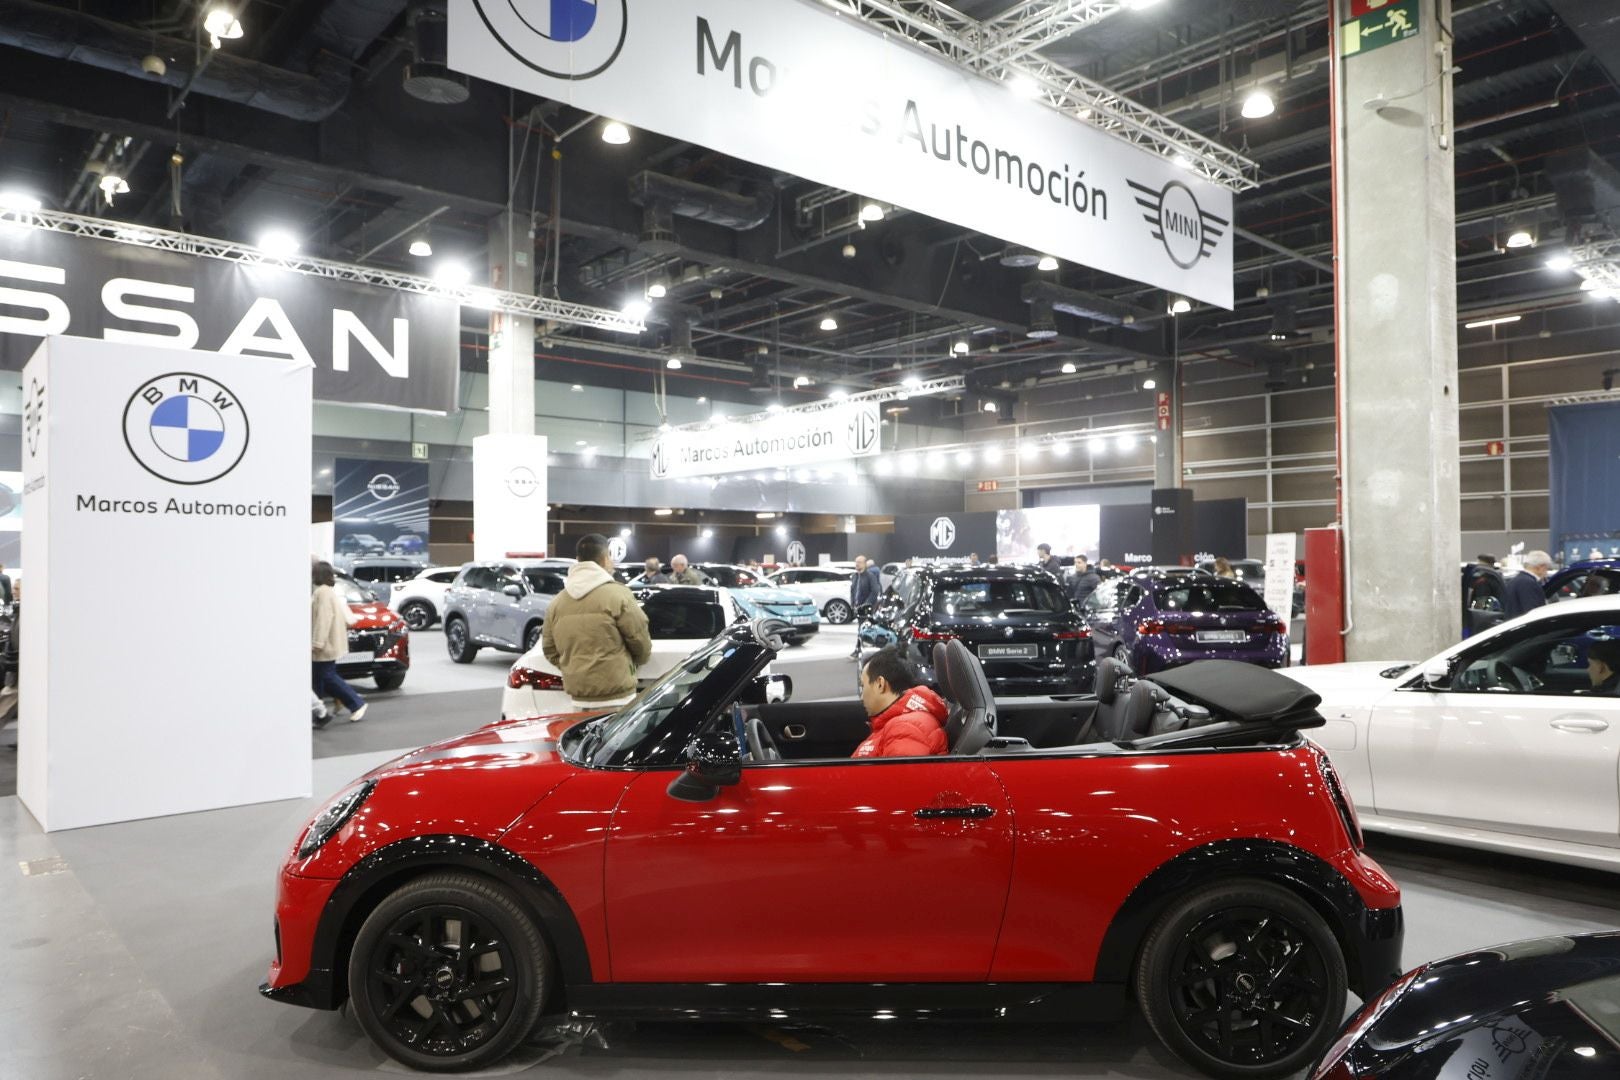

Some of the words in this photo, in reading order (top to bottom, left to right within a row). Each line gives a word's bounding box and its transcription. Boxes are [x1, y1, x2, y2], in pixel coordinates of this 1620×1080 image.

[897, 99, 1107, 220] Automoción
[1165, 208, 1199, 241] MINI
[142, 378, 234, 411] BMW
[734, 427, 833, 457] Automoción
[849, 411, 875, 450] MG
[76, 495, 158, 514] Marcos
[164, 498, 286, 517] Automoción
[932, 519, 953, 547] MG
